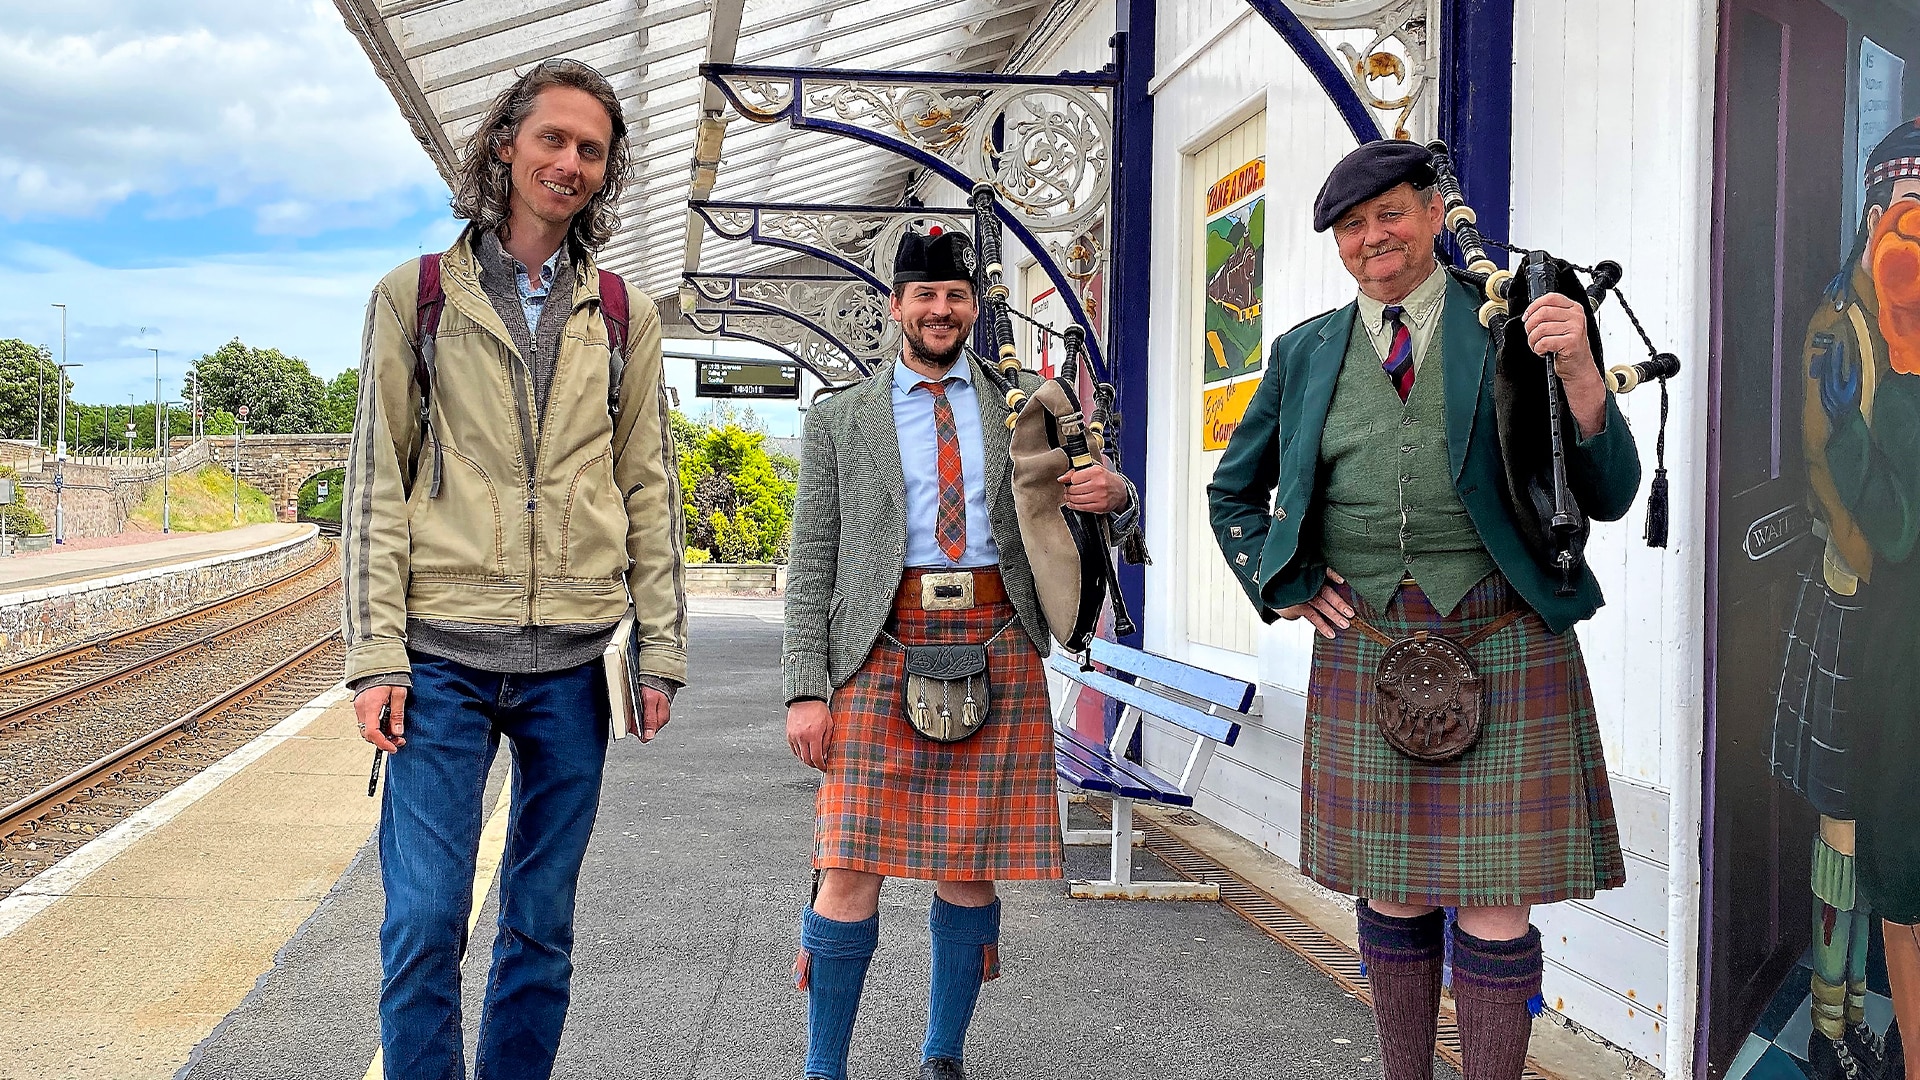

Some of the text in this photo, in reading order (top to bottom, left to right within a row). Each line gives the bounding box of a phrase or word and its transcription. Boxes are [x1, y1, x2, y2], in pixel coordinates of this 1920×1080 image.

[1207, 161, 1260, 214] TAKE A RIDE
[1205, 379, 1237, 425] Enjoy the
